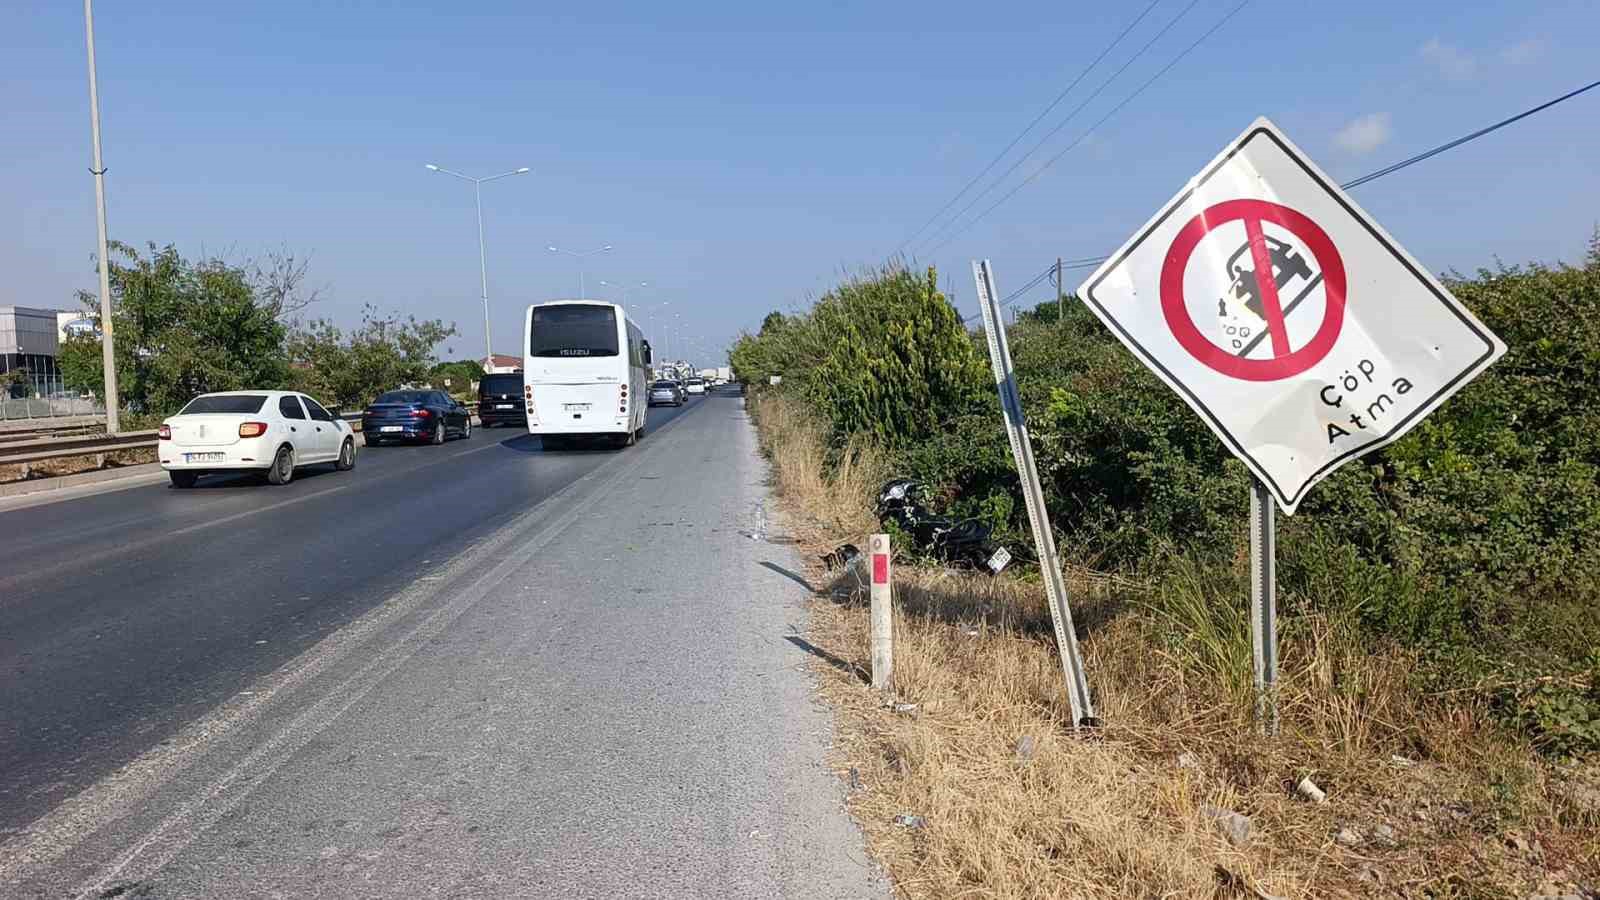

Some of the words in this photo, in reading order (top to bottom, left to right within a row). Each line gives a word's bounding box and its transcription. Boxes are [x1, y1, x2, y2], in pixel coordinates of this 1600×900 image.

[560, 348, 590, 356] ISUZU
[1320, 359, 1375, 408] Çöp
[1327, 377, 1414, 444] Atma
